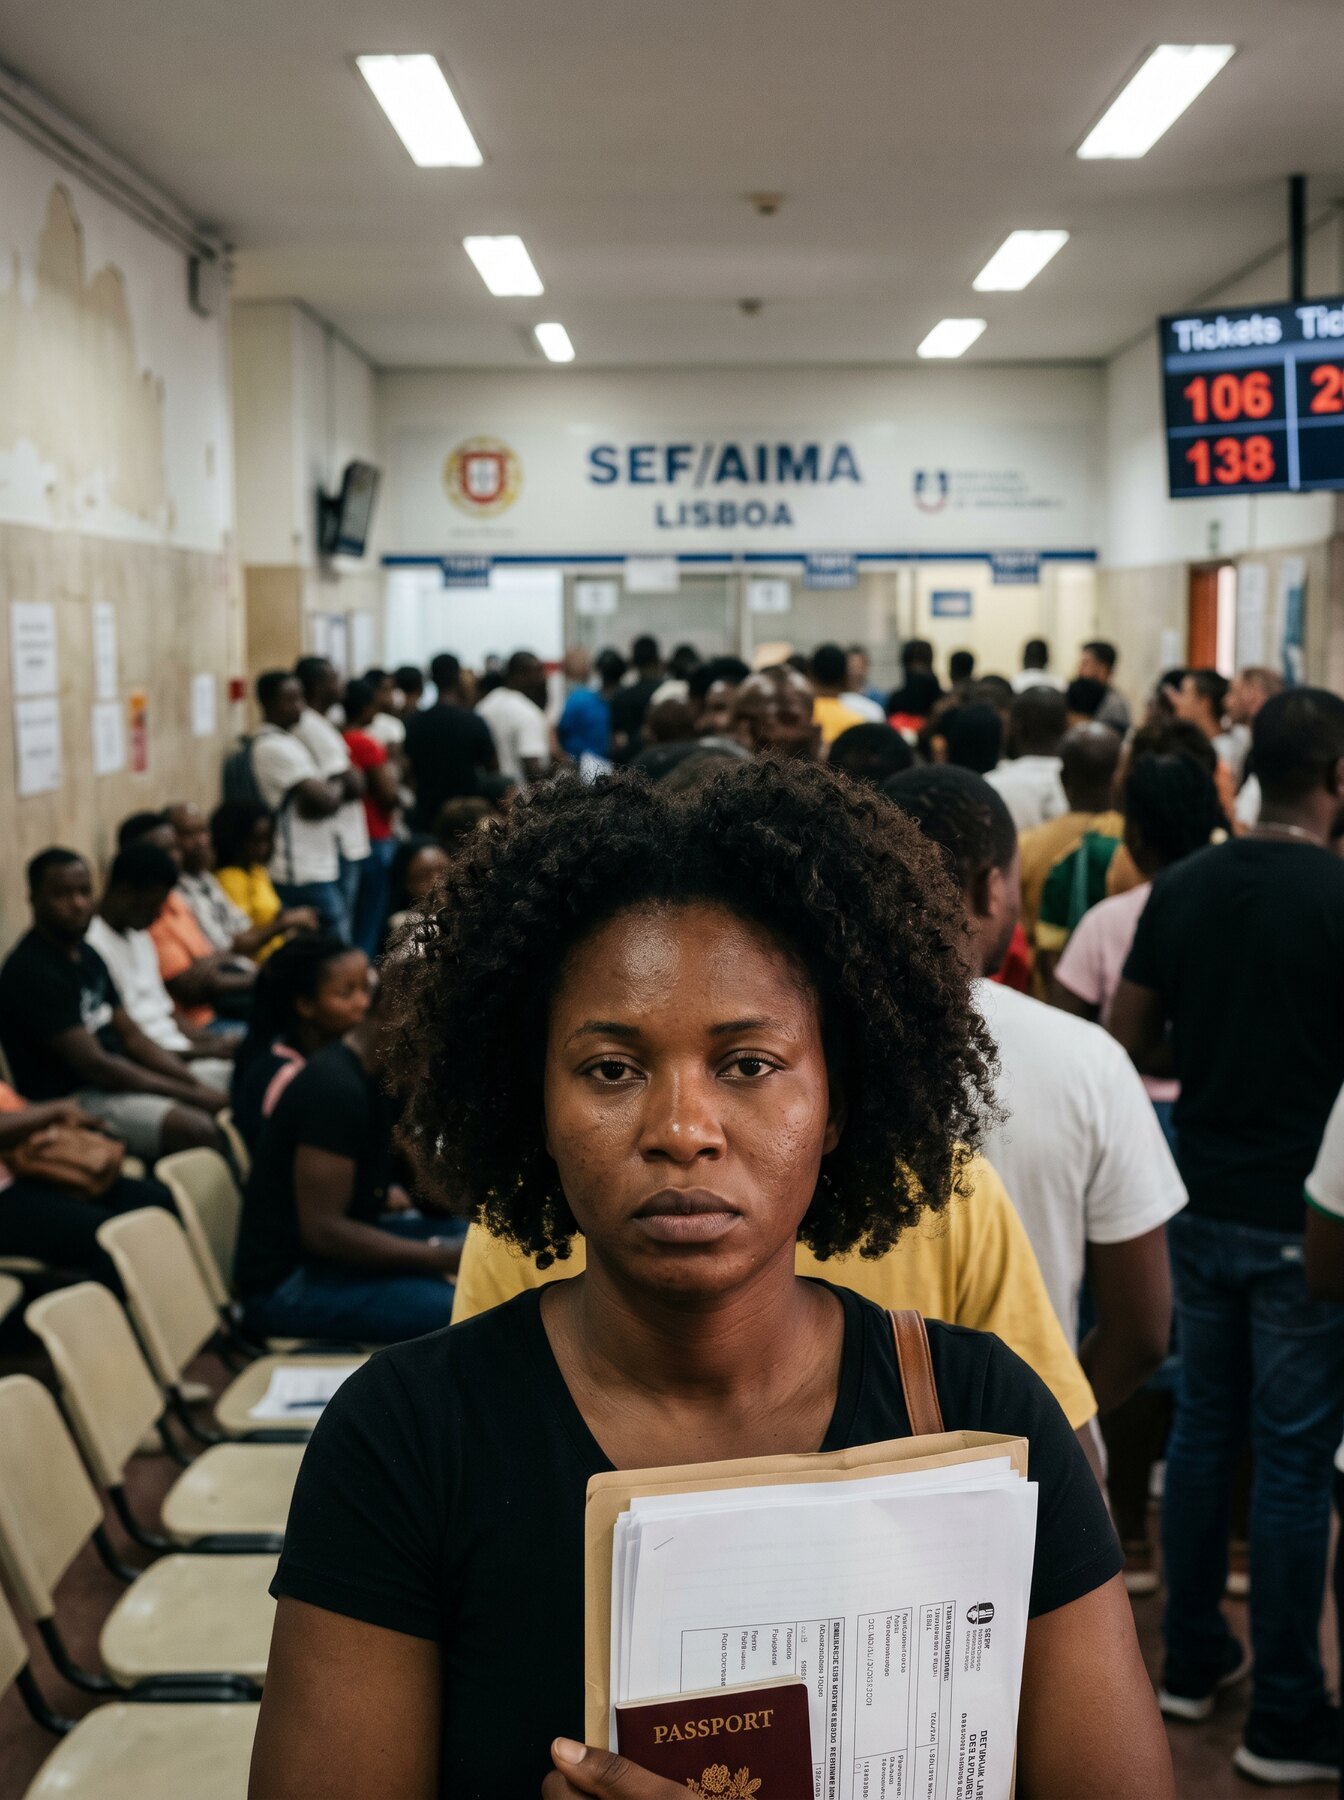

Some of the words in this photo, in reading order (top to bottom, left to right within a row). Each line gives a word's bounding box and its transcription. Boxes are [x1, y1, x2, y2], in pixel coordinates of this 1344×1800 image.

[1171, 314, 1283, 352] Tickets
[1184, 370, 1274, 424] 106
[1310, 364, 1344, 414] 2
[588, 442, 861, 486] SEF/AIMA
[1185, 434, 1276, 486] 138
[655, 502, 793, 529] LISBOA
[653, 1708, 775, 1745] PASSPORT
